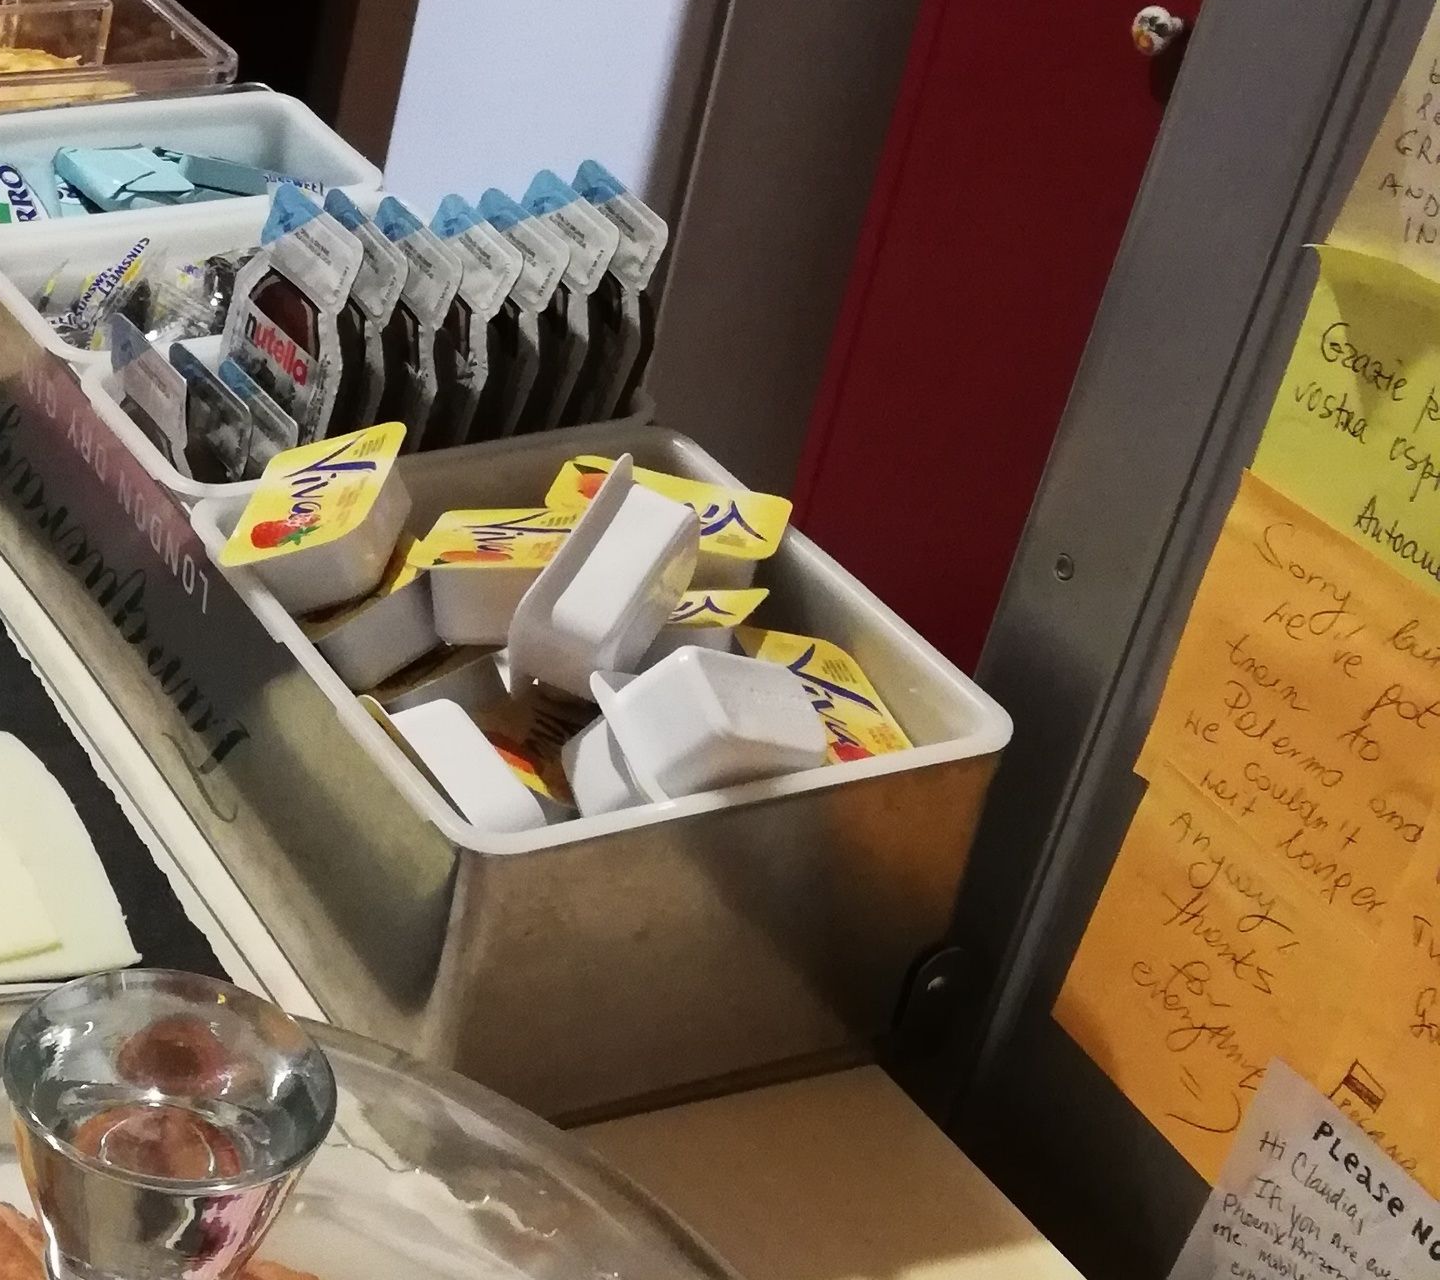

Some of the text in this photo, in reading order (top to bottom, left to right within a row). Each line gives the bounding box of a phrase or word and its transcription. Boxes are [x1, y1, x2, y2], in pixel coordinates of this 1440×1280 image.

[244, 312, 309, 387] nutella
[66, 408, 107, 483] DRY
[279, 431, 378, 523] Viva
[115, 480, 210, 615] LONDON
[786, 642, 884, 747] Viva
[1259, 1130, 1287, 1161] Hi
